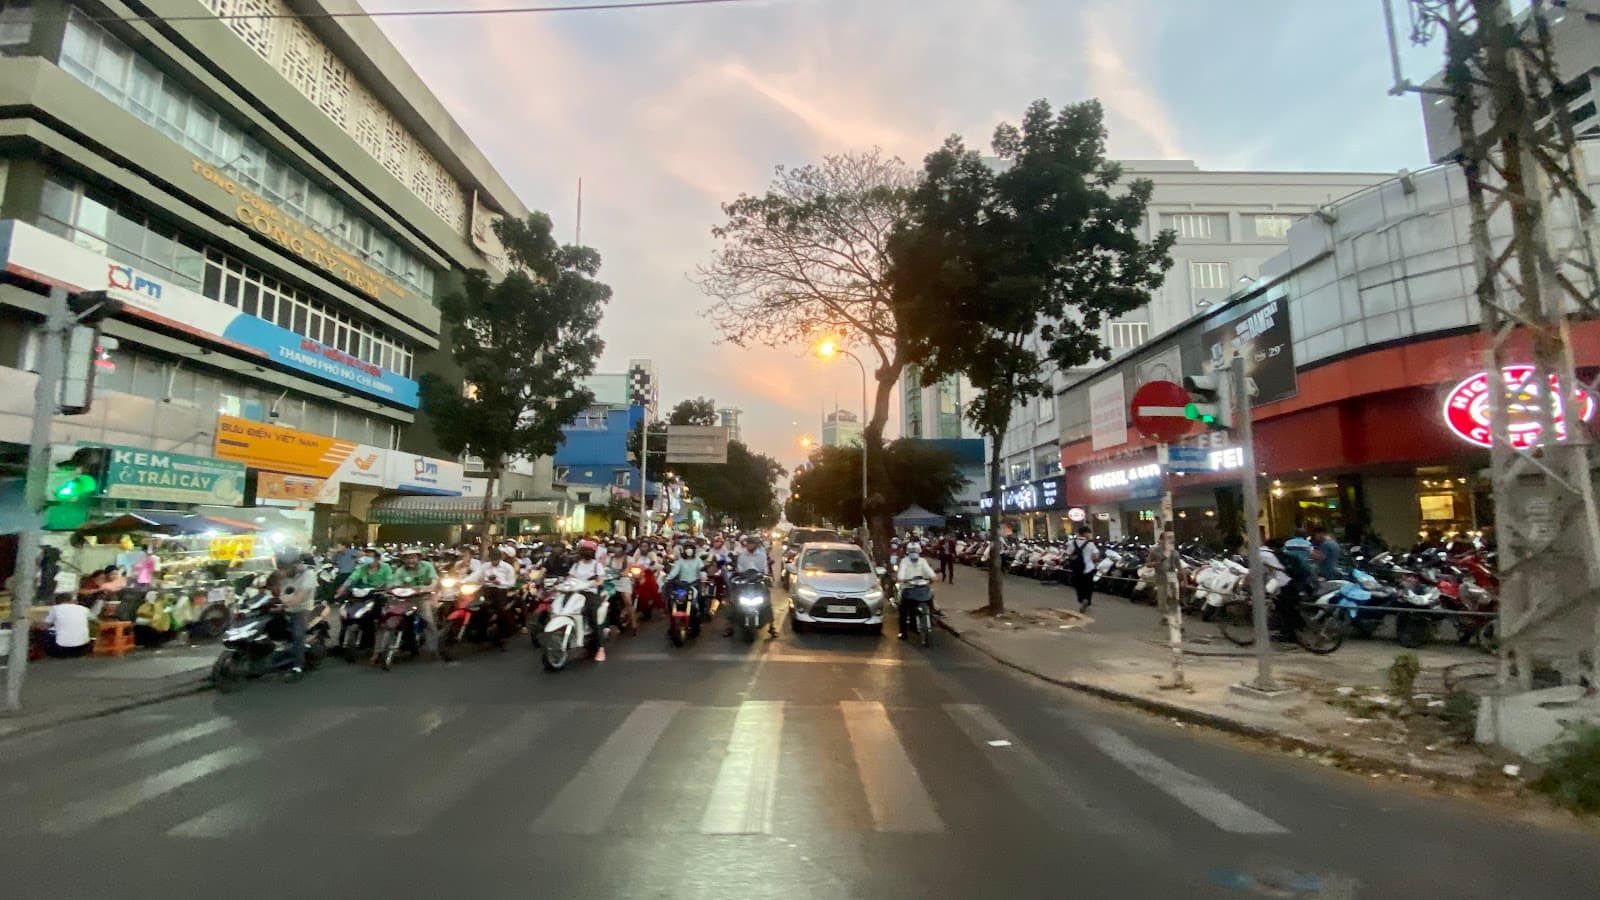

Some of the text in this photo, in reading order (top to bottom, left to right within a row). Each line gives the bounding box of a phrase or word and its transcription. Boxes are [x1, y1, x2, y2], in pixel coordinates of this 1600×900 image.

[312, 248, 338, 273] TY
[114, 450, 170, 469] KEM
[137, 467, 176, 486] TRÁI
[180, 471, 211, 489] CÂY
